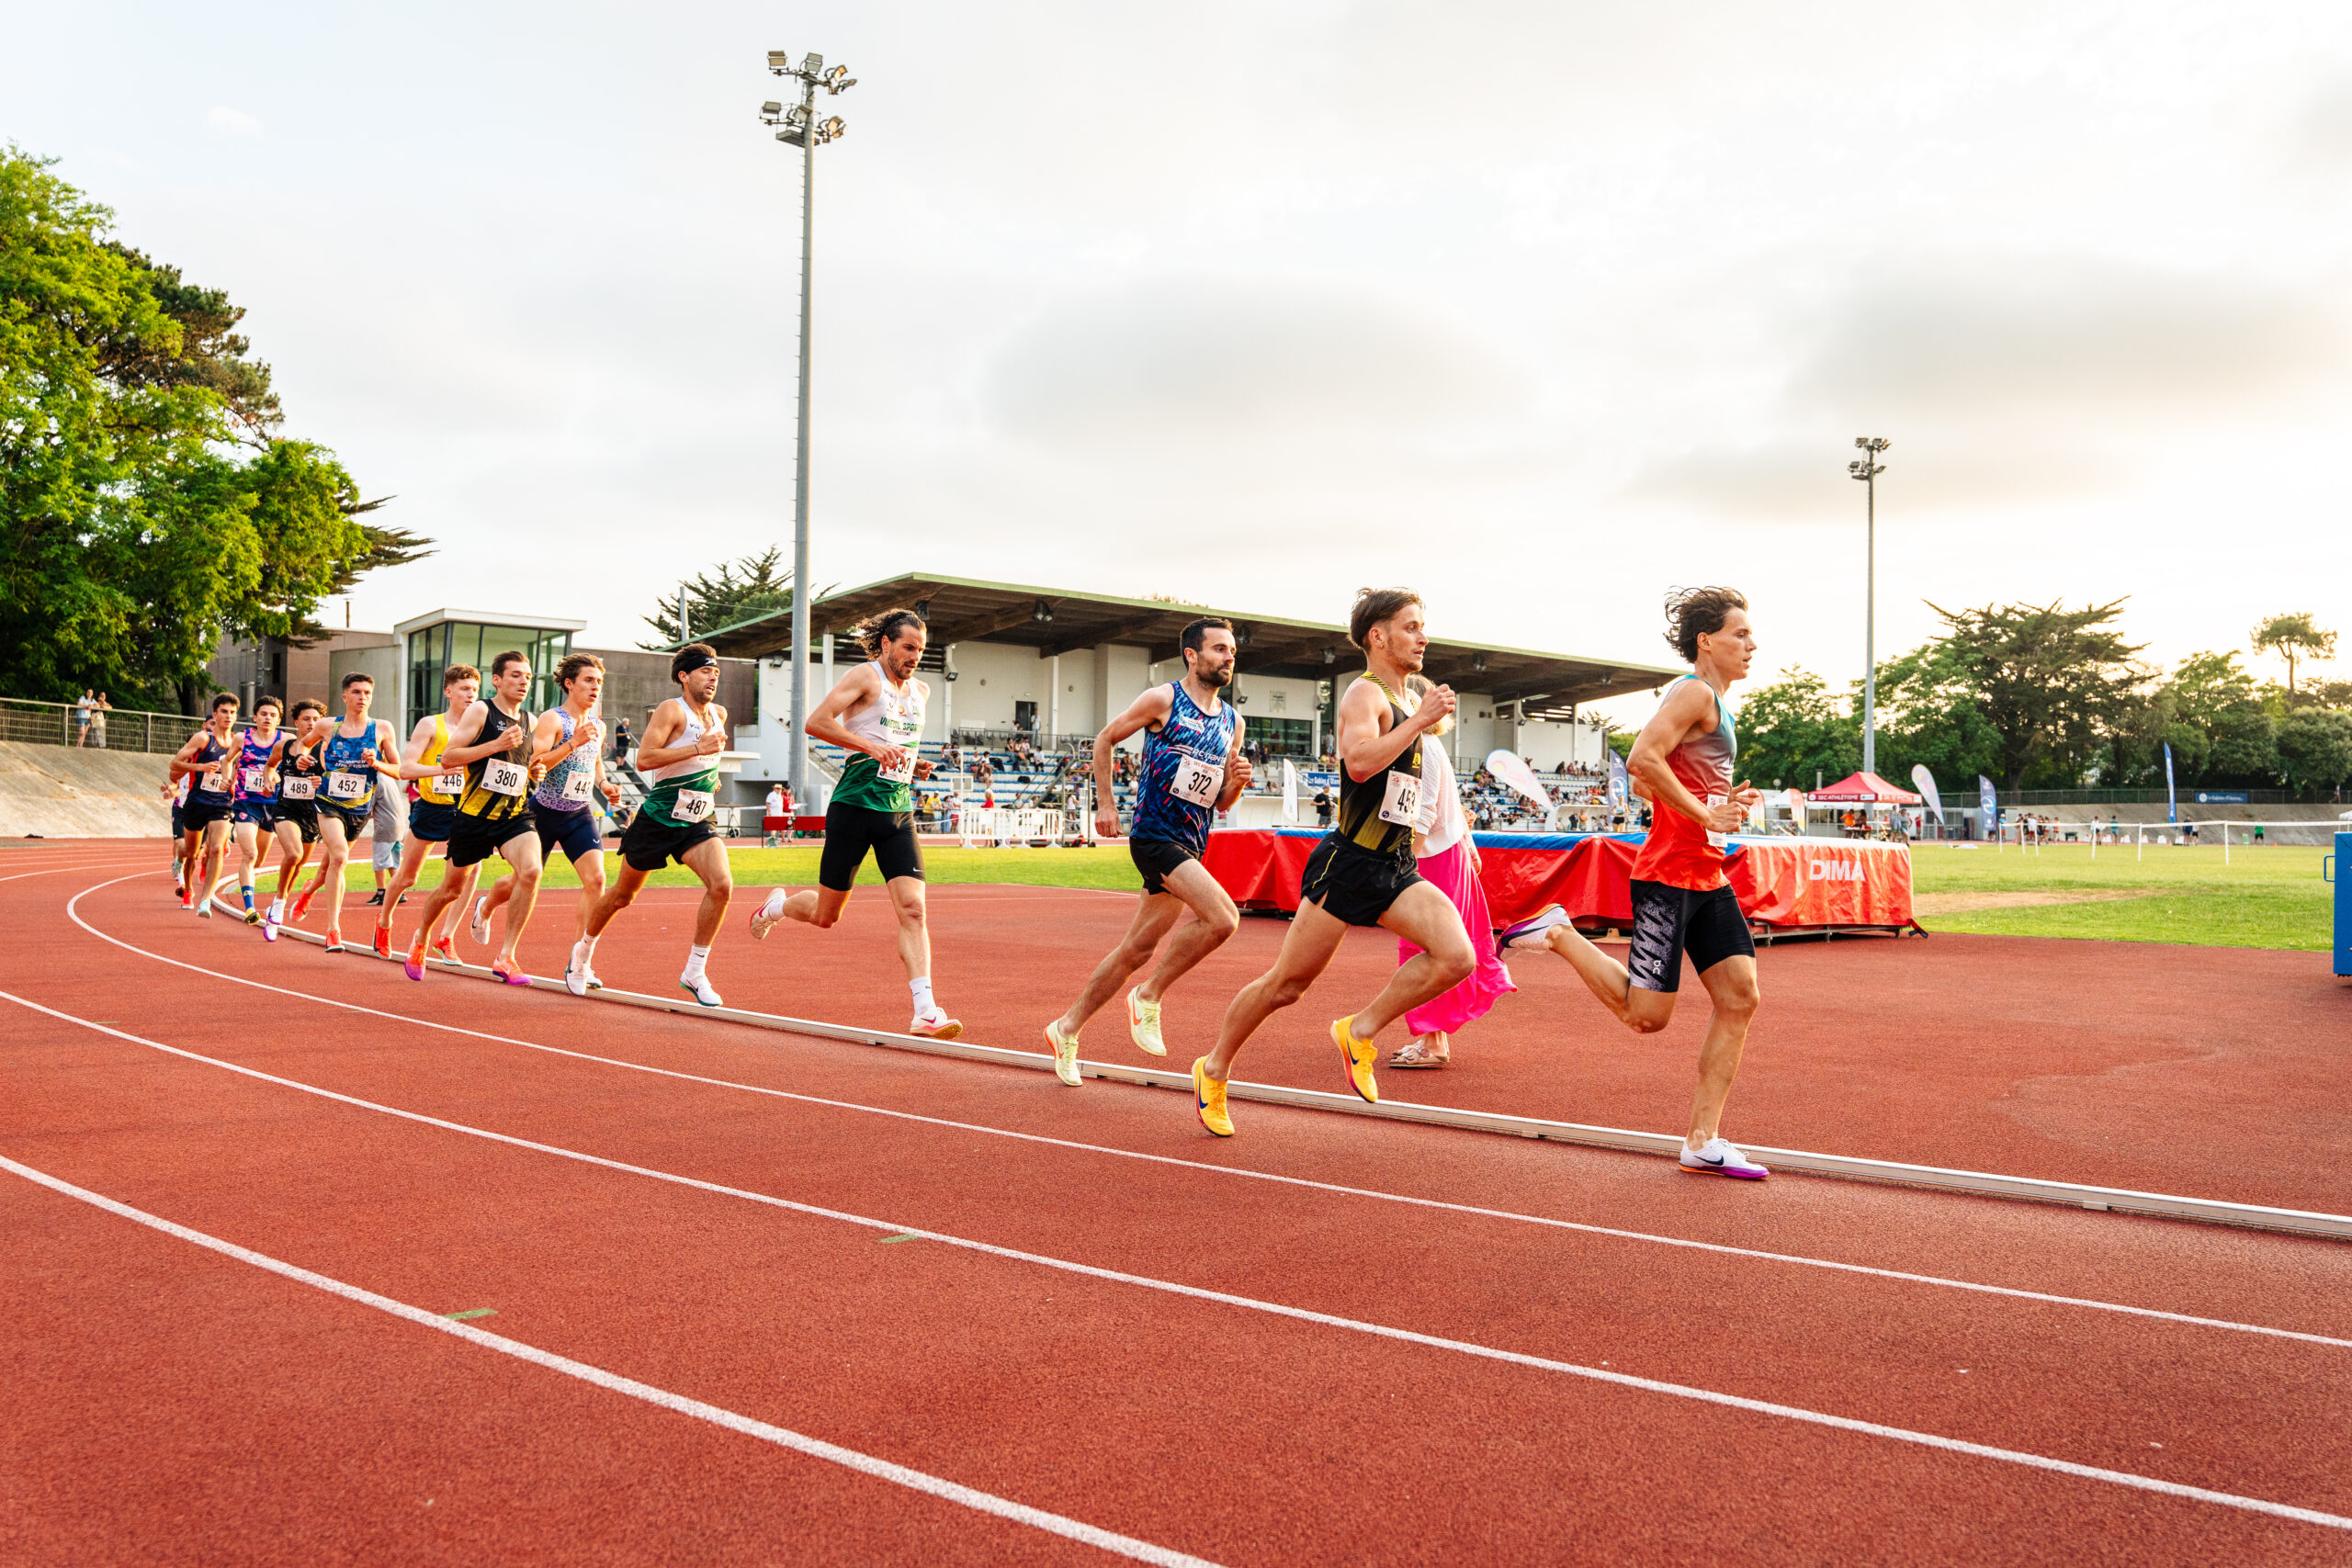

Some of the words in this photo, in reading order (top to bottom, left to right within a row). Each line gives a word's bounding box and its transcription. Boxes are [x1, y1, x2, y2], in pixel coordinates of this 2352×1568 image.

[254, 777, 264, 787] 41
[338, 780, 357, 792] 452
[443, 774, 462, 787] 446
[495, 770, 518, 787] 380
[1189, 772, 1212, 795] 372
[290, 784, 308, 794] 489
[686, 799, 707, 816] 487
[1809, 860, 1866, 882] DIMA
